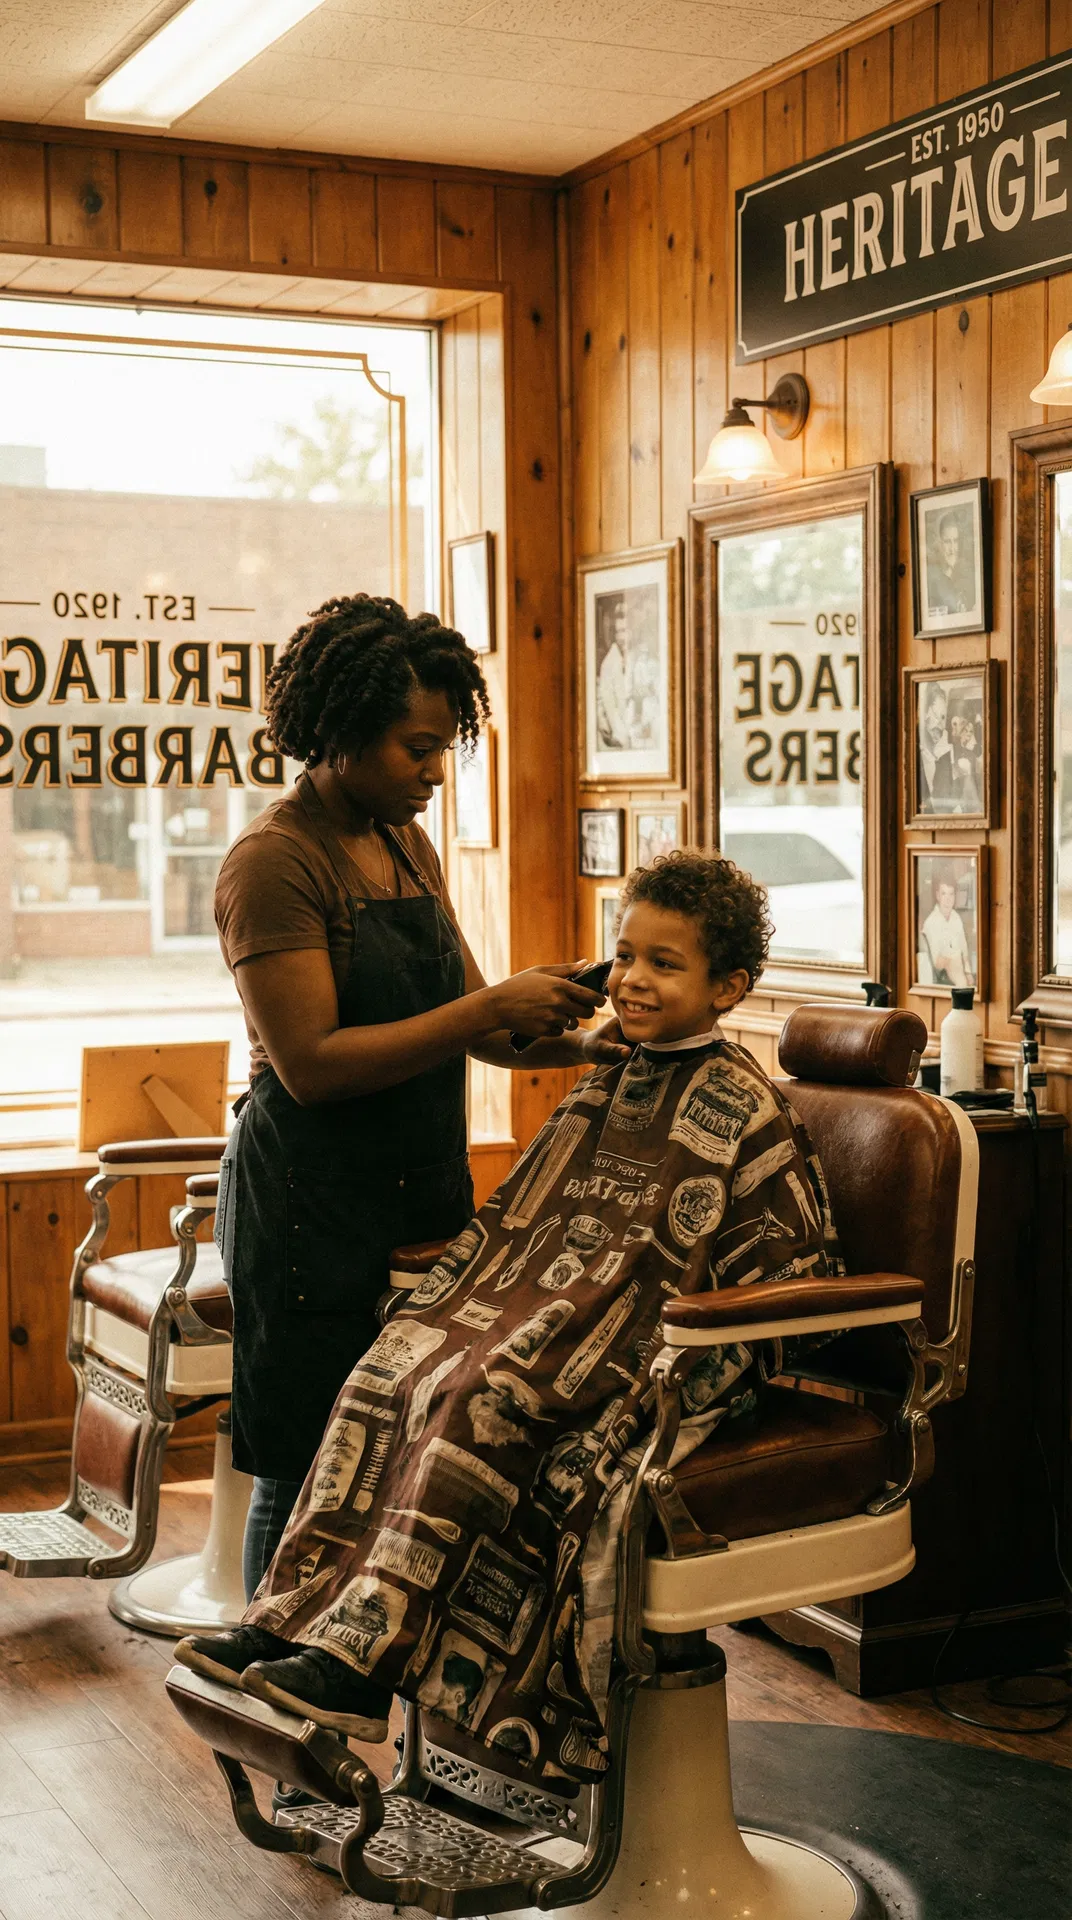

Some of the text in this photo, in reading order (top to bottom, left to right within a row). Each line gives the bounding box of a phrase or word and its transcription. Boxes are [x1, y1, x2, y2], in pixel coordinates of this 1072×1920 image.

[911, 101, 1004, 164] EST. 1950
[783, 119, 1067, 303] HERITAGE
